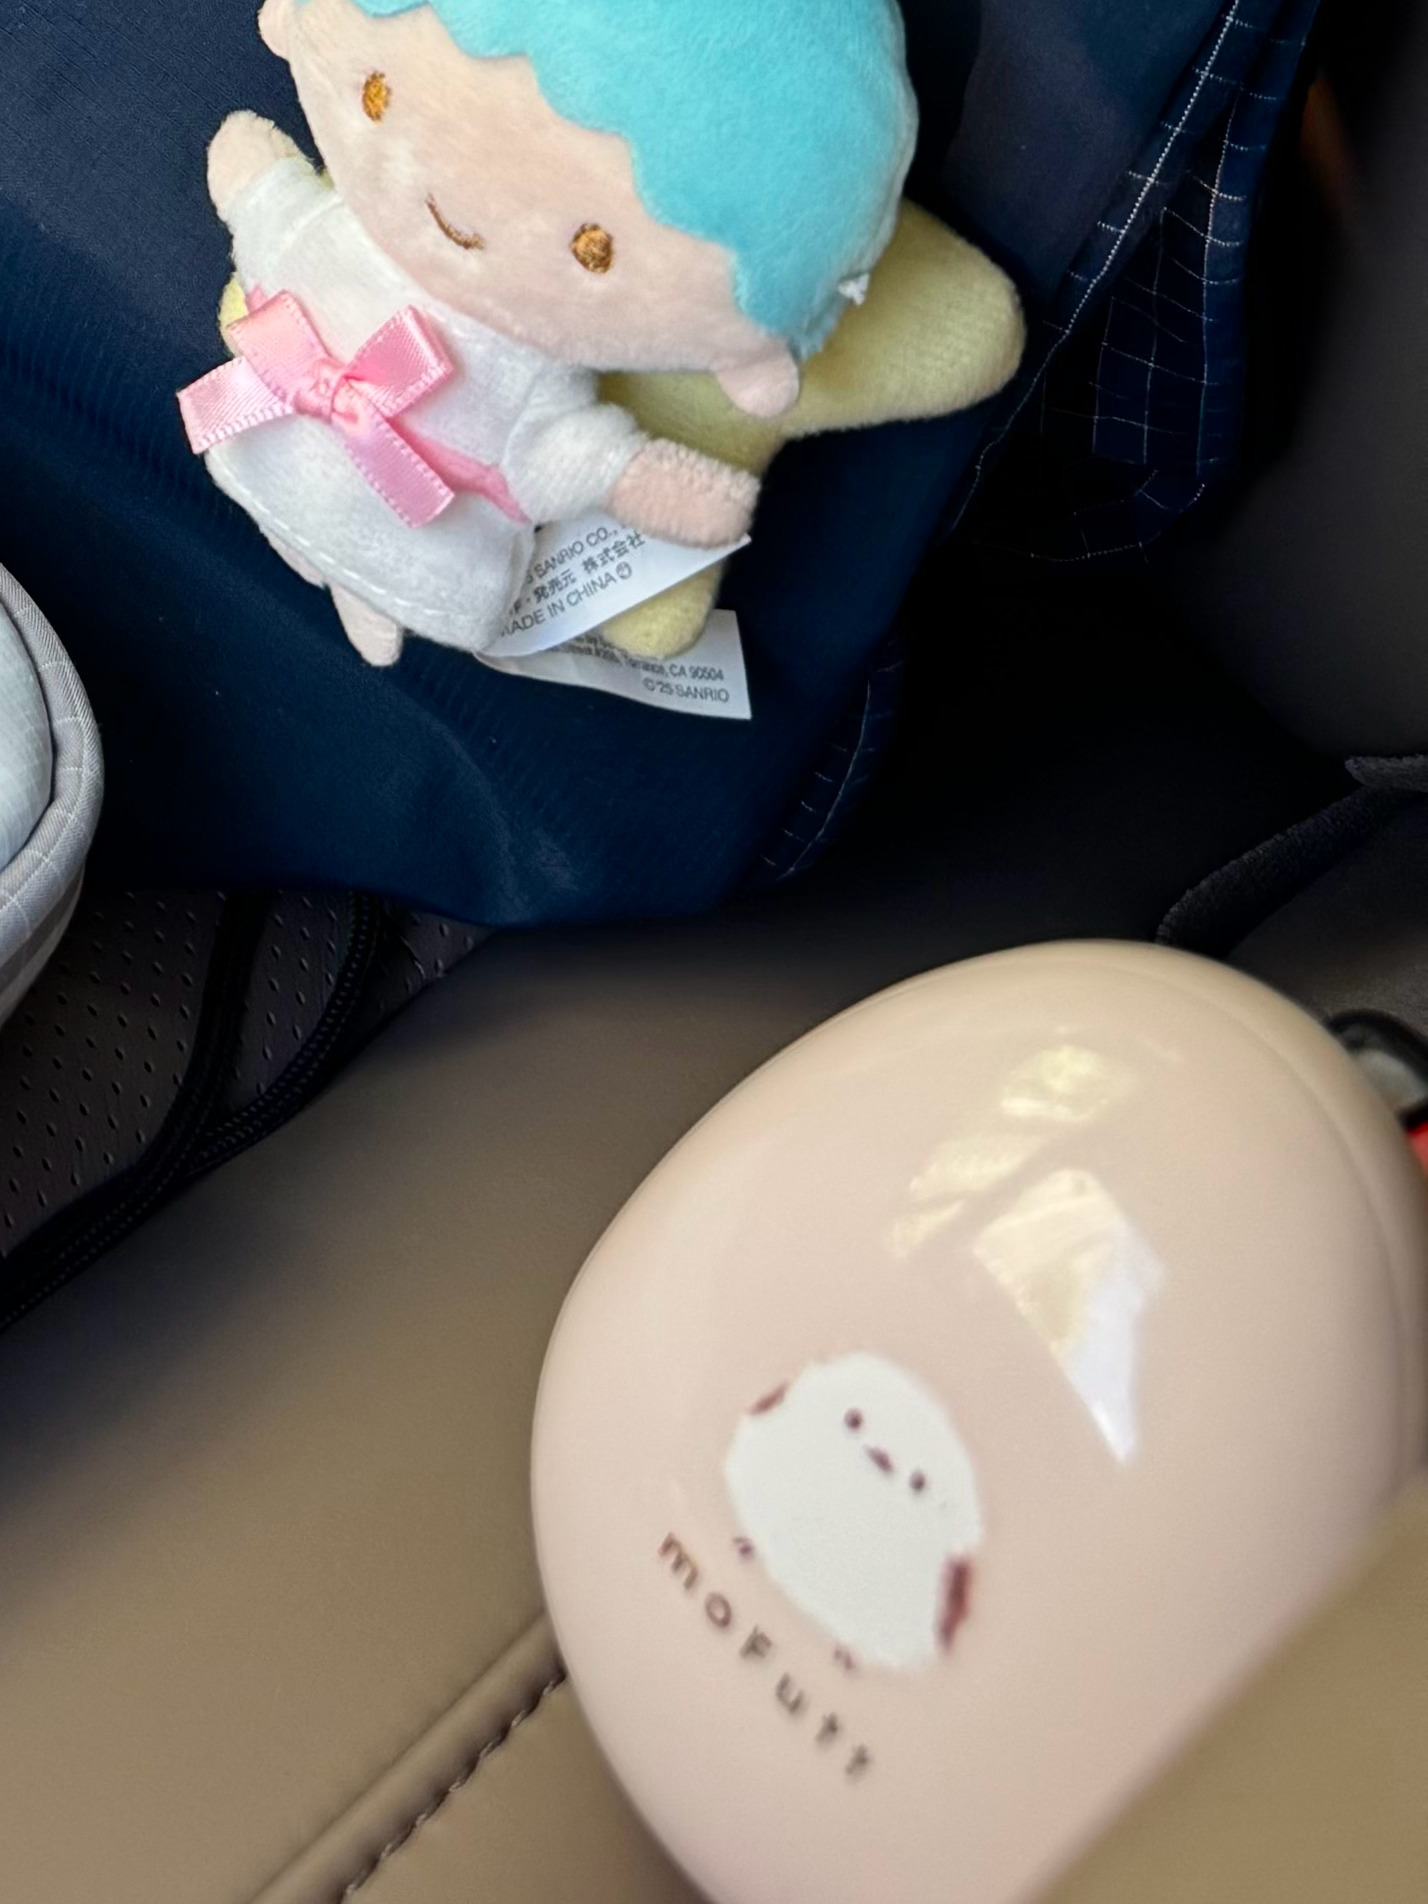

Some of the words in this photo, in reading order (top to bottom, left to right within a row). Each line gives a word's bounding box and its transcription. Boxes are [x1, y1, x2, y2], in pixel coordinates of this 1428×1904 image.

[534, 540, 584, 579] SANRIO
[547, 598, 566, 618] IN
[566, 571, 618, 607] CHINA
[675, 683, 731, 704] SANRIO
